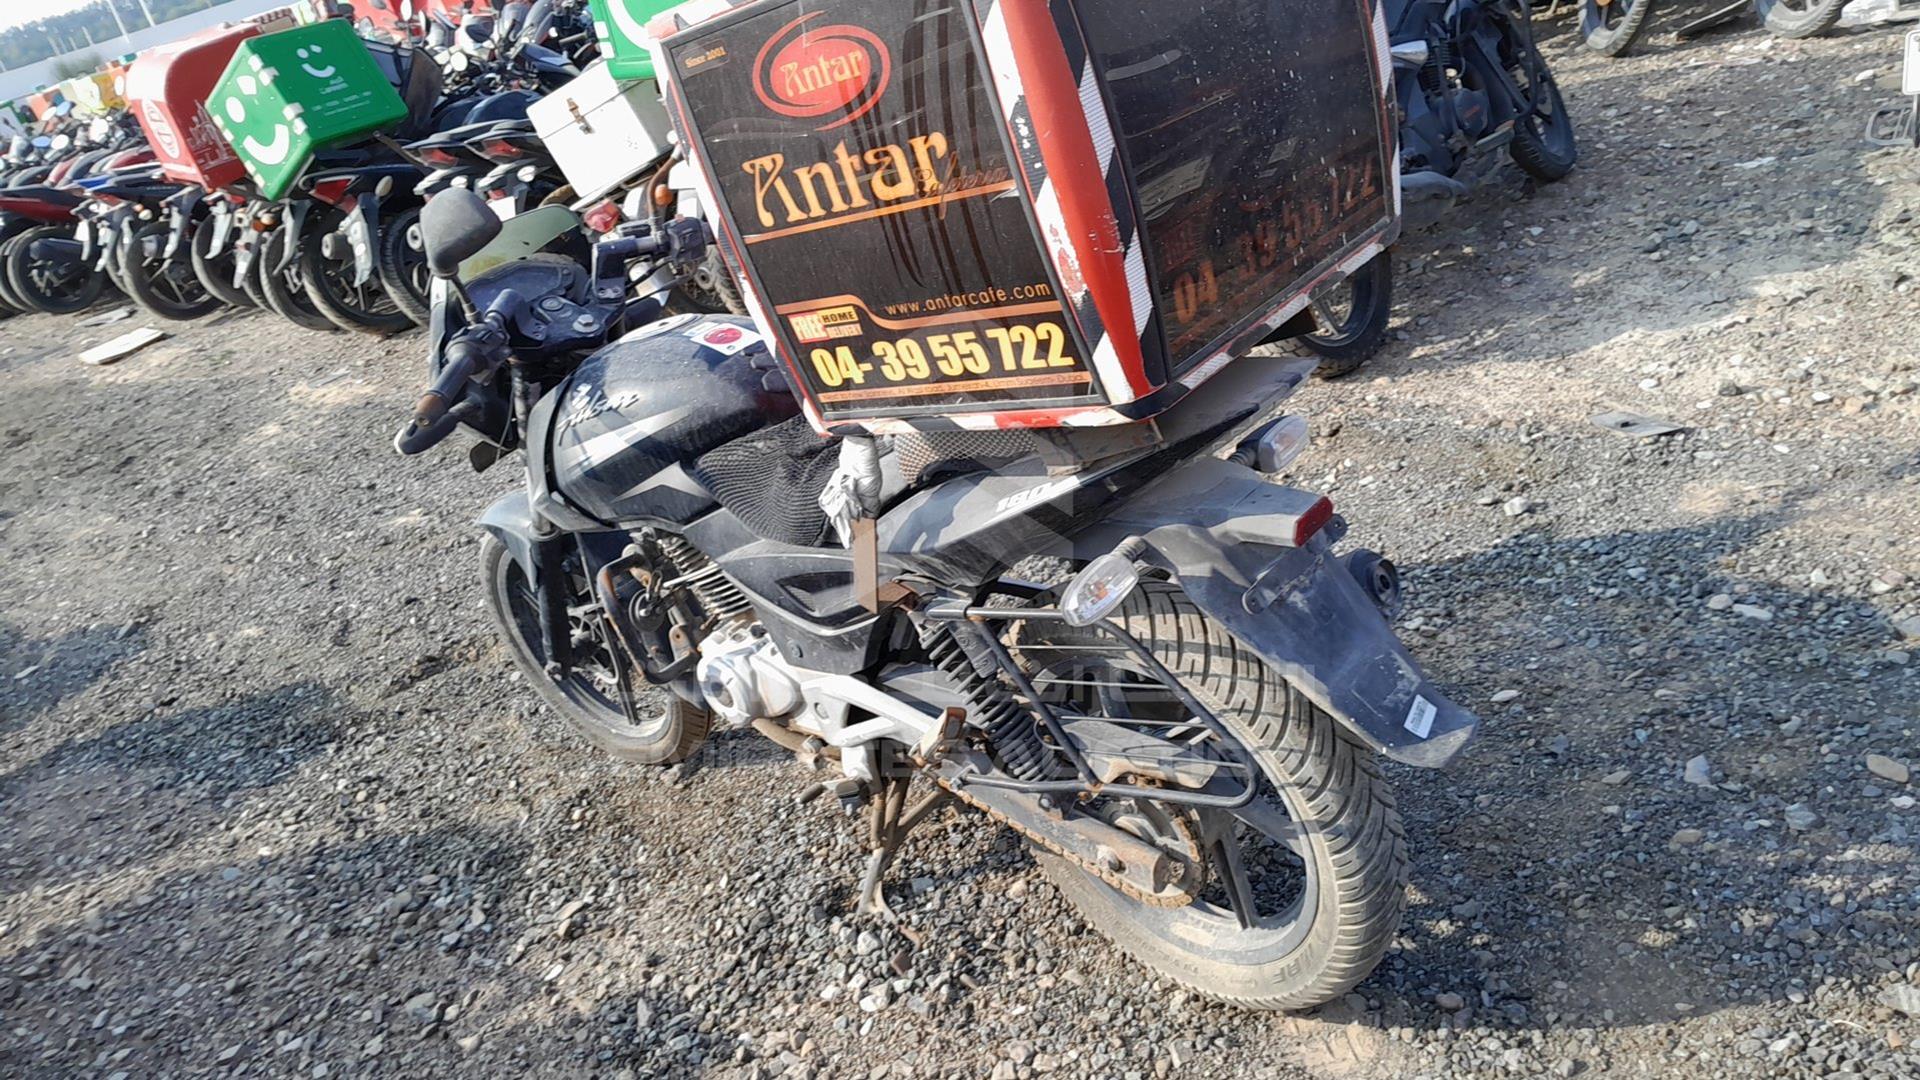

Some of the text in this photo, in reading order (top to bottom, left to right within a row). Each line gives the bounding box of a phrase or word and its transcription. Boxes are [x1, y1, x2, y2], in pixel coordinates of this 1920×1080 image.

[780, 50, 863, 97] Antar
[742, 132, 947, 227] Antar
[821, 311, 855, 323] HOME
[885, 282, 1051, 316] www.antarcafe.com
[810, 322, 1075, 387] 04- 39 55 722
[996, 482, 1052, 513] 180
